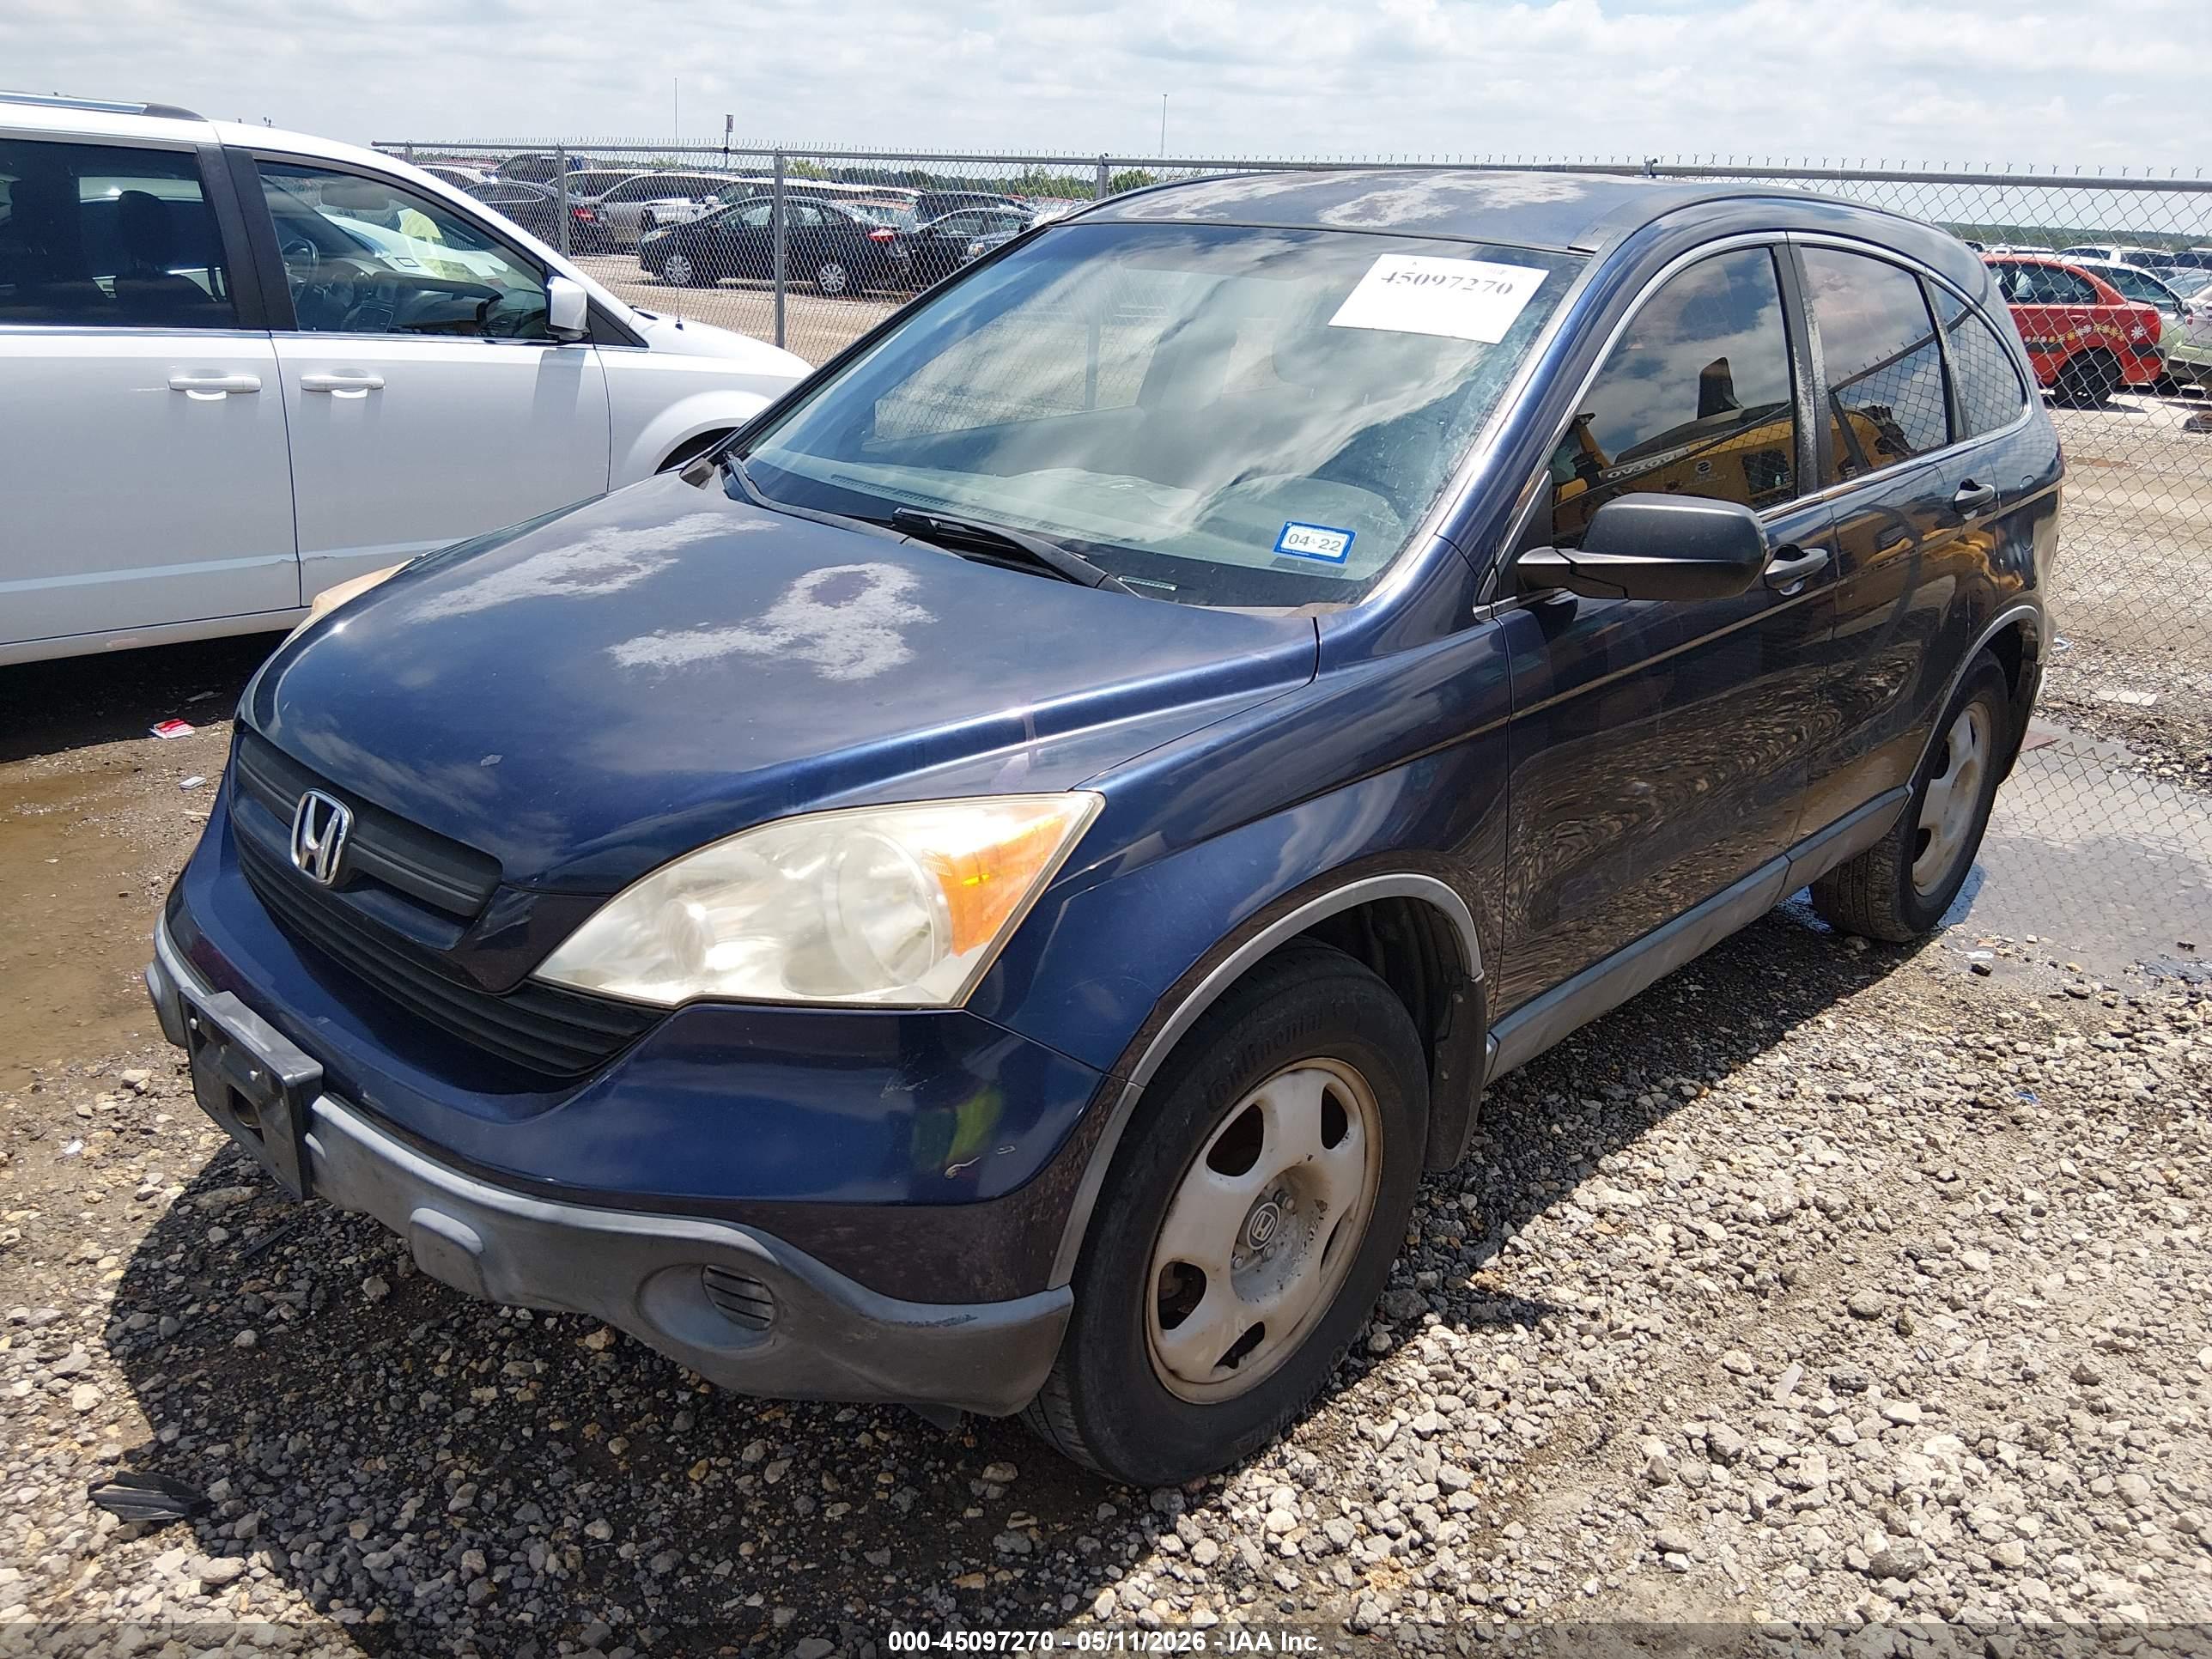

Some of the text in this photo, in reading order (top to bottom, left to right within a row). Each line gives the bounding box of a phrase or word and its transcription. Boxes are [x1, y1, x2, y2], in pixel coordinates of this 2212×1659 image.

[1381, 271, 1513, 295] 45097270
[1288, 533, 1310, 546] 04
[1317, 538, 1341, 552] 22
